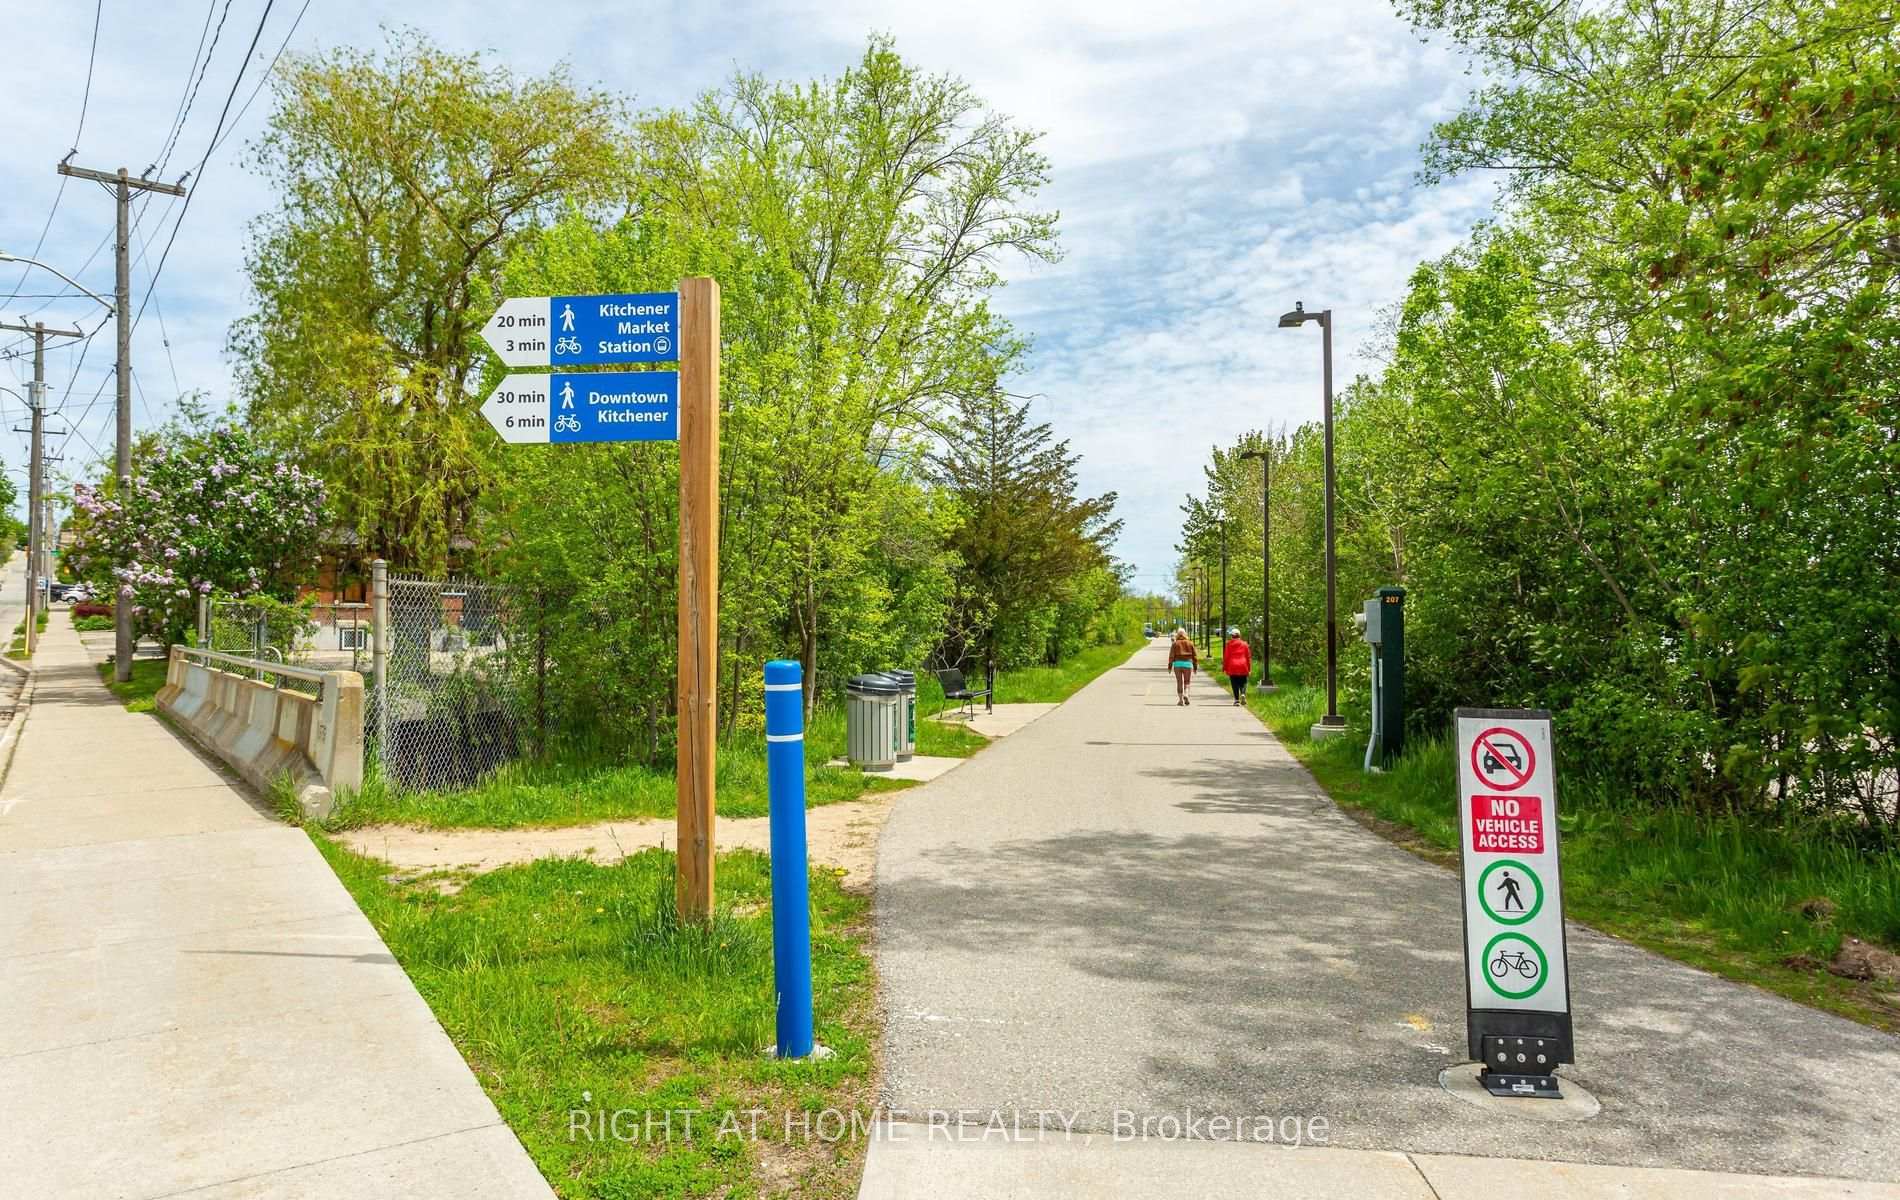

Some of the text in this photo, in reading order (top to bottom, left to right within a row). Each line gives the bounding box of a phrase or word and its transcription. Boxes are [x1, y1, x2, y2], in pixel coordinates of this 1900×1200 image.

[599, 303, 670, 317] Kitchener
[497, 314, 546, 328] 20 min
[618, 321, 670, 335] Market
[506, 338, 546, 352] 3 min
[599, 340, 651, 354] Station
[497, 390, 545, 404] 30 min
[589, 391, 668, 405] Downtown
[505, 415, 545, 428] 6 min
[598, 409, 669, 423] Kitchener
[1491, 799, 1520, 817] NO
[1475, 819, 1539, 834] VEHICLE
[1478, 834, 1538, 849] ACCESS
